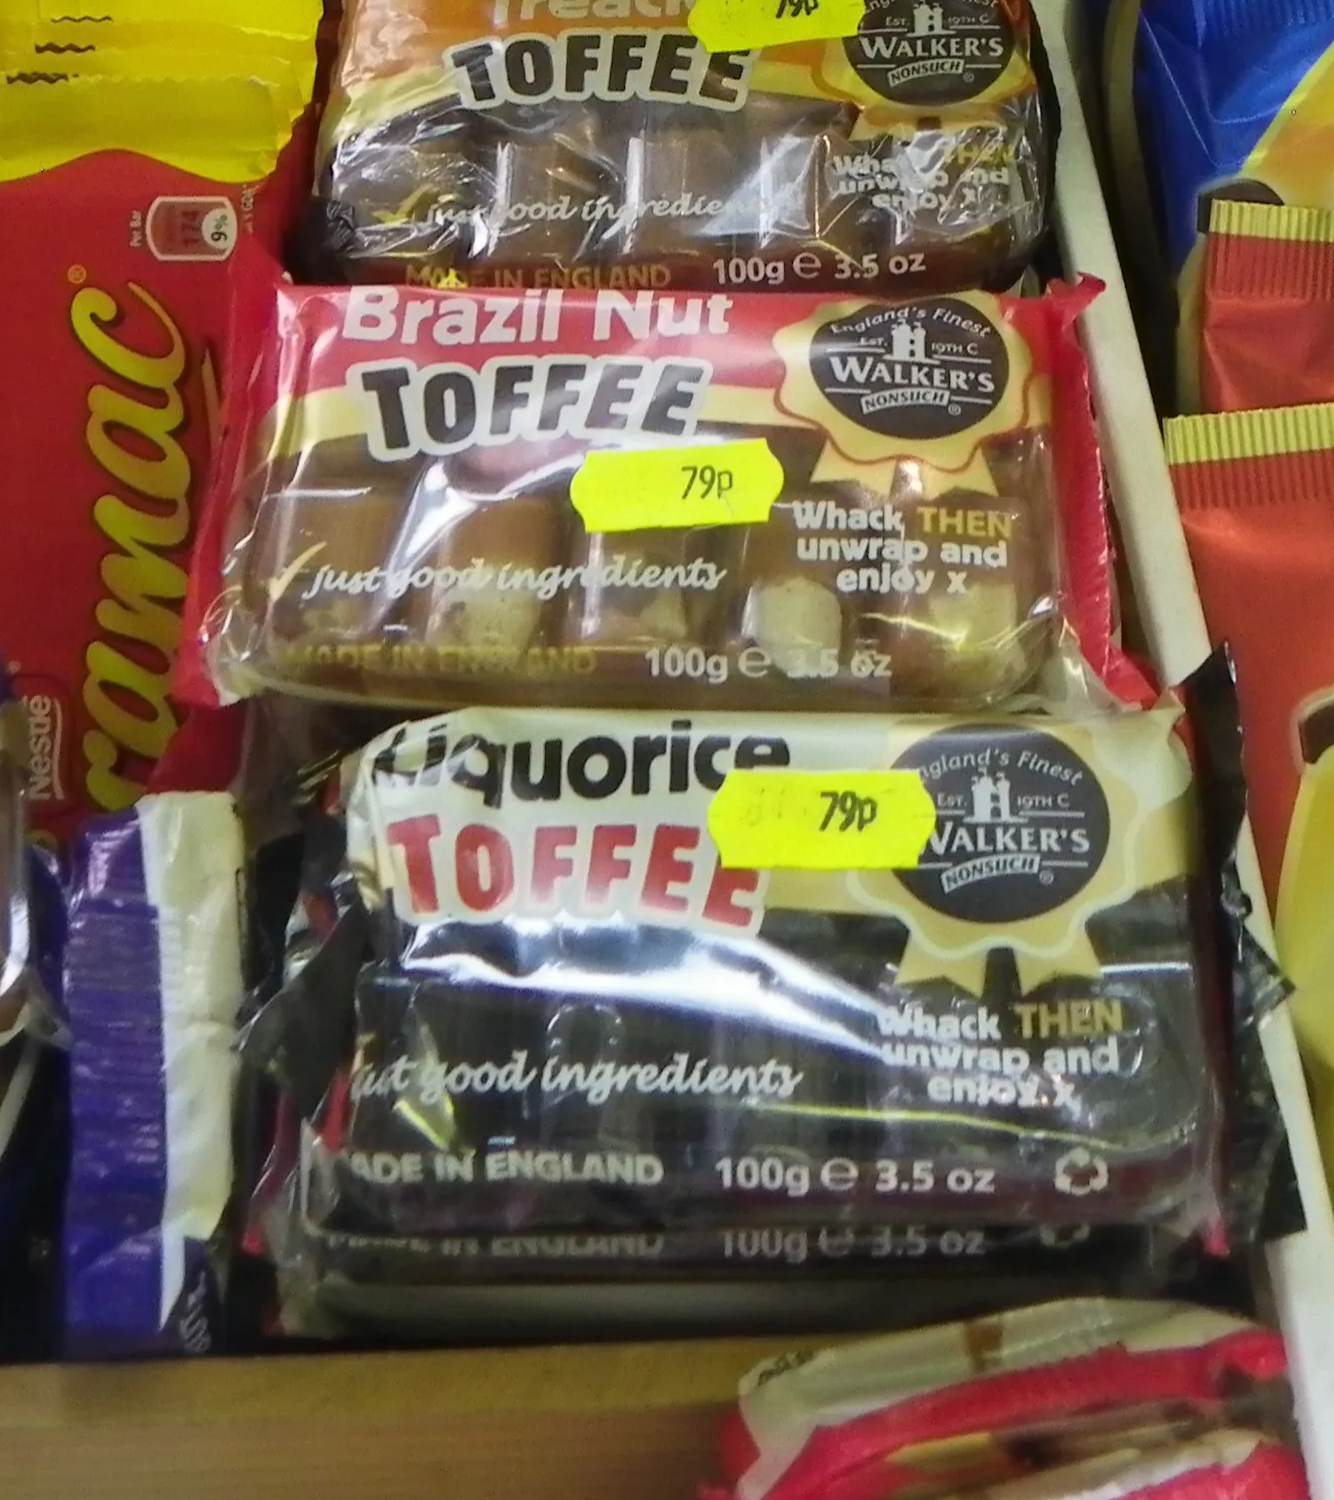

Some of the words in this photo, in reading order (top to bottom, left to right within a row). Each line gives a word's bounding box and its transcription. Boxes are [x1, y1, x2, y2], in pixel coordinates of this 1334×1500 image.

[858, 35, 1005, 59] WALKER'S
[451, 35, 755, 104] TOFFEE
[888, 60, 963, 85] NONSUCH
[712, 256, 786, 288] 100g
[834, 254, 879, 280] 3.5
[888, 254, 926, 275] oz
[342, 287, 573, 348] Brazil
[593, 289, 732, 343] Nut
[829, 306, 928, 338] England's
[931, 307, 992, 340] Finest
[824, 356, 997, 393] WALKER'S
[358, 361, 705, 451] TOFFEE
[862, 392, 948, 413] NONSUCH
[680, 465, 734, 502] 79p
[793, 502, 904, 534] Whack
[916, 507, 1013, 537] THEN
[69, 281, 192, 812] ramac
[795, 534, 930, 569] unwrap
[939, 539, 1009, 568] and
[394, 562, 490, 605] good
[495, 556, 727, 602] ingredients
[836, 565, 936, 595] enjoy
[944, 571, 968, 594] x
[645, 649, 731, 683] 100g
[787, 649, 841, 678] 3.5
[850, 649, 893, 678] oz
[372, 719, 791, 808] Liquorice
[819, 790, 877, 835] 79p
[387, 815, 762, 929] TOFFEE
[943, 856, 1039, 891] NONSUCH
[419, 1053, 536, 1099] good
[541, 1056, 804, 1099] ingredients
[716, 1158, 811, 1198] 100g
[875, 1159, 934, 1193] 3.5
[944, 1163, 997, 1195] oz
